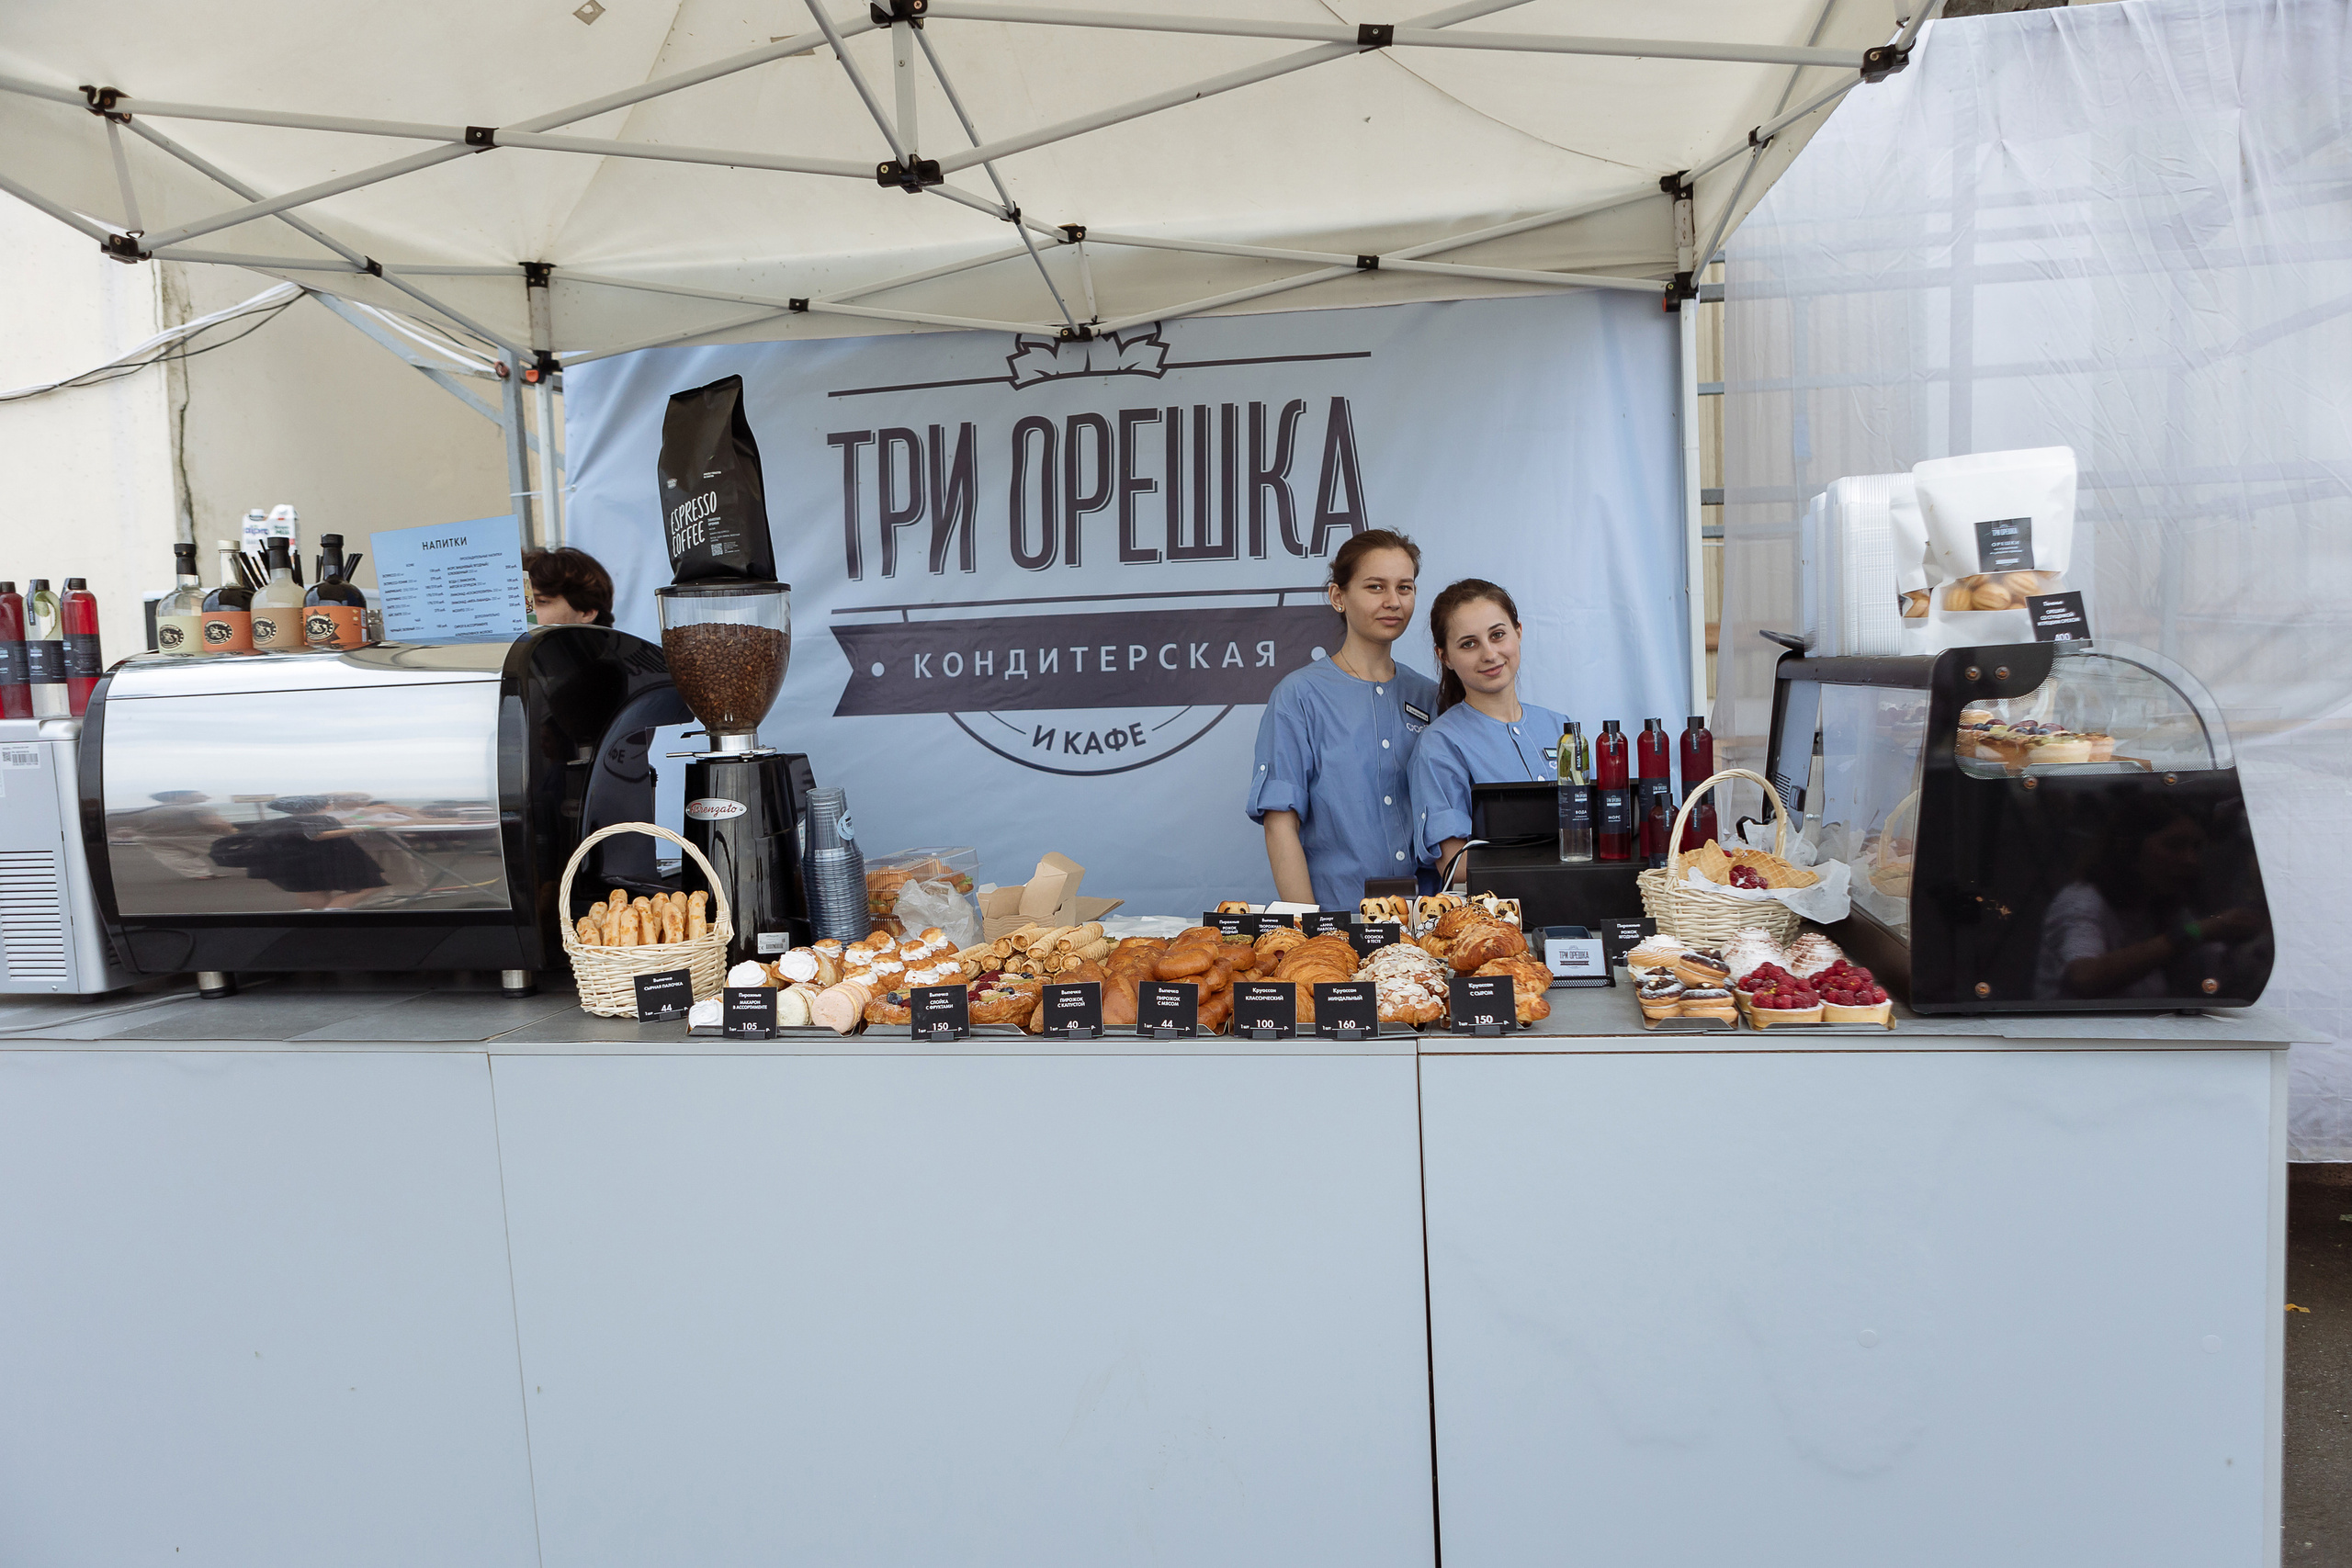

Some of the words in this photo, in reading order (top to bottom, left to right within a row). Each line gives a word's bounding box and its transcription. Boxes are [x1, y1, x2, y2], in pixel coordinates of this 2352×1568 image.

[827, 422, 978, 581] ТРИ
[1011, 397, 1369, 571] ОРЕШКА
[671, 491, 717, 536] ESPRESSO
[422, 536, 468, 550] НАПИТКИ
[673, 521, 706, 558] COFFEE
[914, 640, 1276, 681] КОНДИТЕРСКАЯ
[1031, 725, 1056, 751] И
[1063, 722, 1147, 755] КАФЕ
[1559, 951, 1568, 959] ТРИ
[1569, 951, 1589, 959] ОРЕШКА
[661, 1004, 673, 1012] 44
[1160, 1020, 1173, 1028] 44
[1256, 1020, 1274, 1028] 100
[1475, 1015, 1494, 1024] 150
[742, 1022, 757, 1031] 105
[932, 1022, 949, 1031] 150
[1067, 1021, 1079, 1029] 40
[1338, 1020, 1356, 1029] 160
